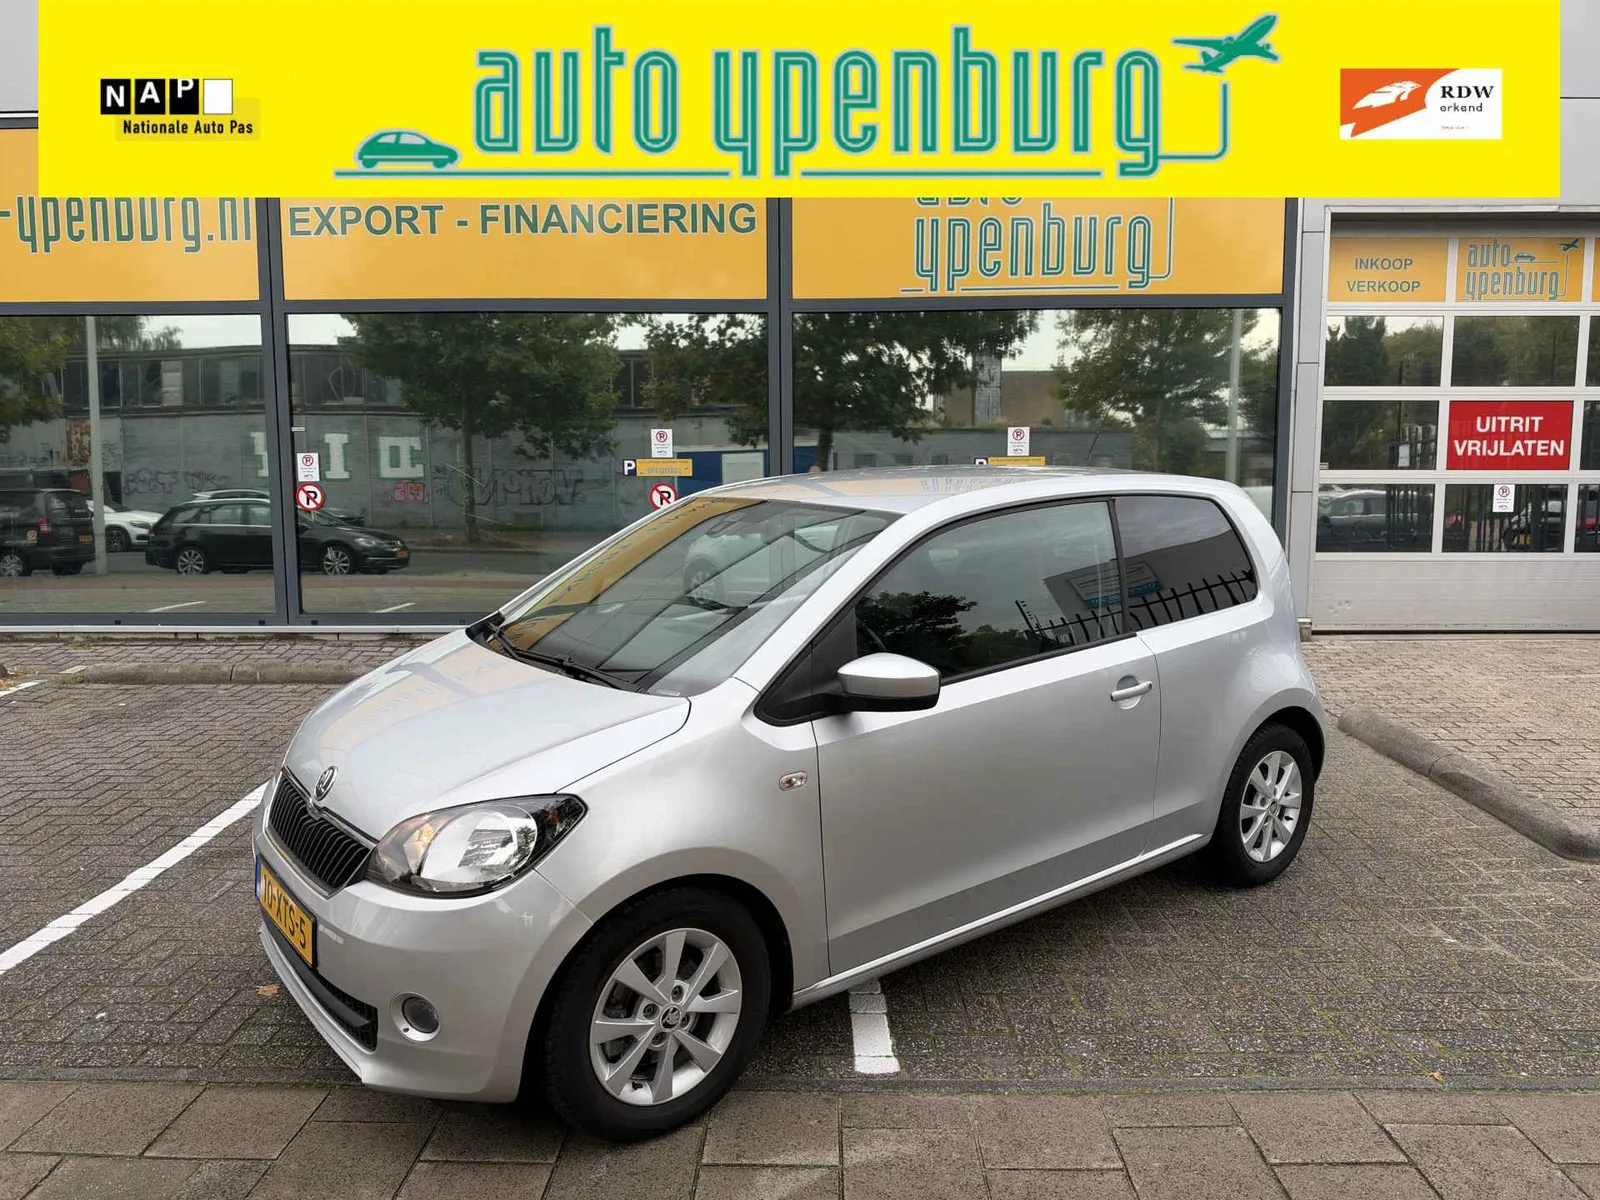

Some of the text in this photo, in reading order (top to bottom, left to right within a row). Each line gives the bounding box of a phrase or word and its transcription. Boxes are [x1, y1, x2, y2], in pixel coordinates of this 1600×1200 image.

[289, 205, 444, 236] EXPORT
[480, 203, 757, 234] FINANCIERING
[915, 202, 1152, 291] ypenburg
[1467, 239, 1511, 268] auto
[1354, 257, 1413, 272] INKOOP
[1346, 280, 1421, 294] VERKOOP
[1465, 266, 1559, 300] ypenburg
[1476, 416, 1544, 434] UITRIT
[1454, 439, 1565, 457] VRIJLATEN
